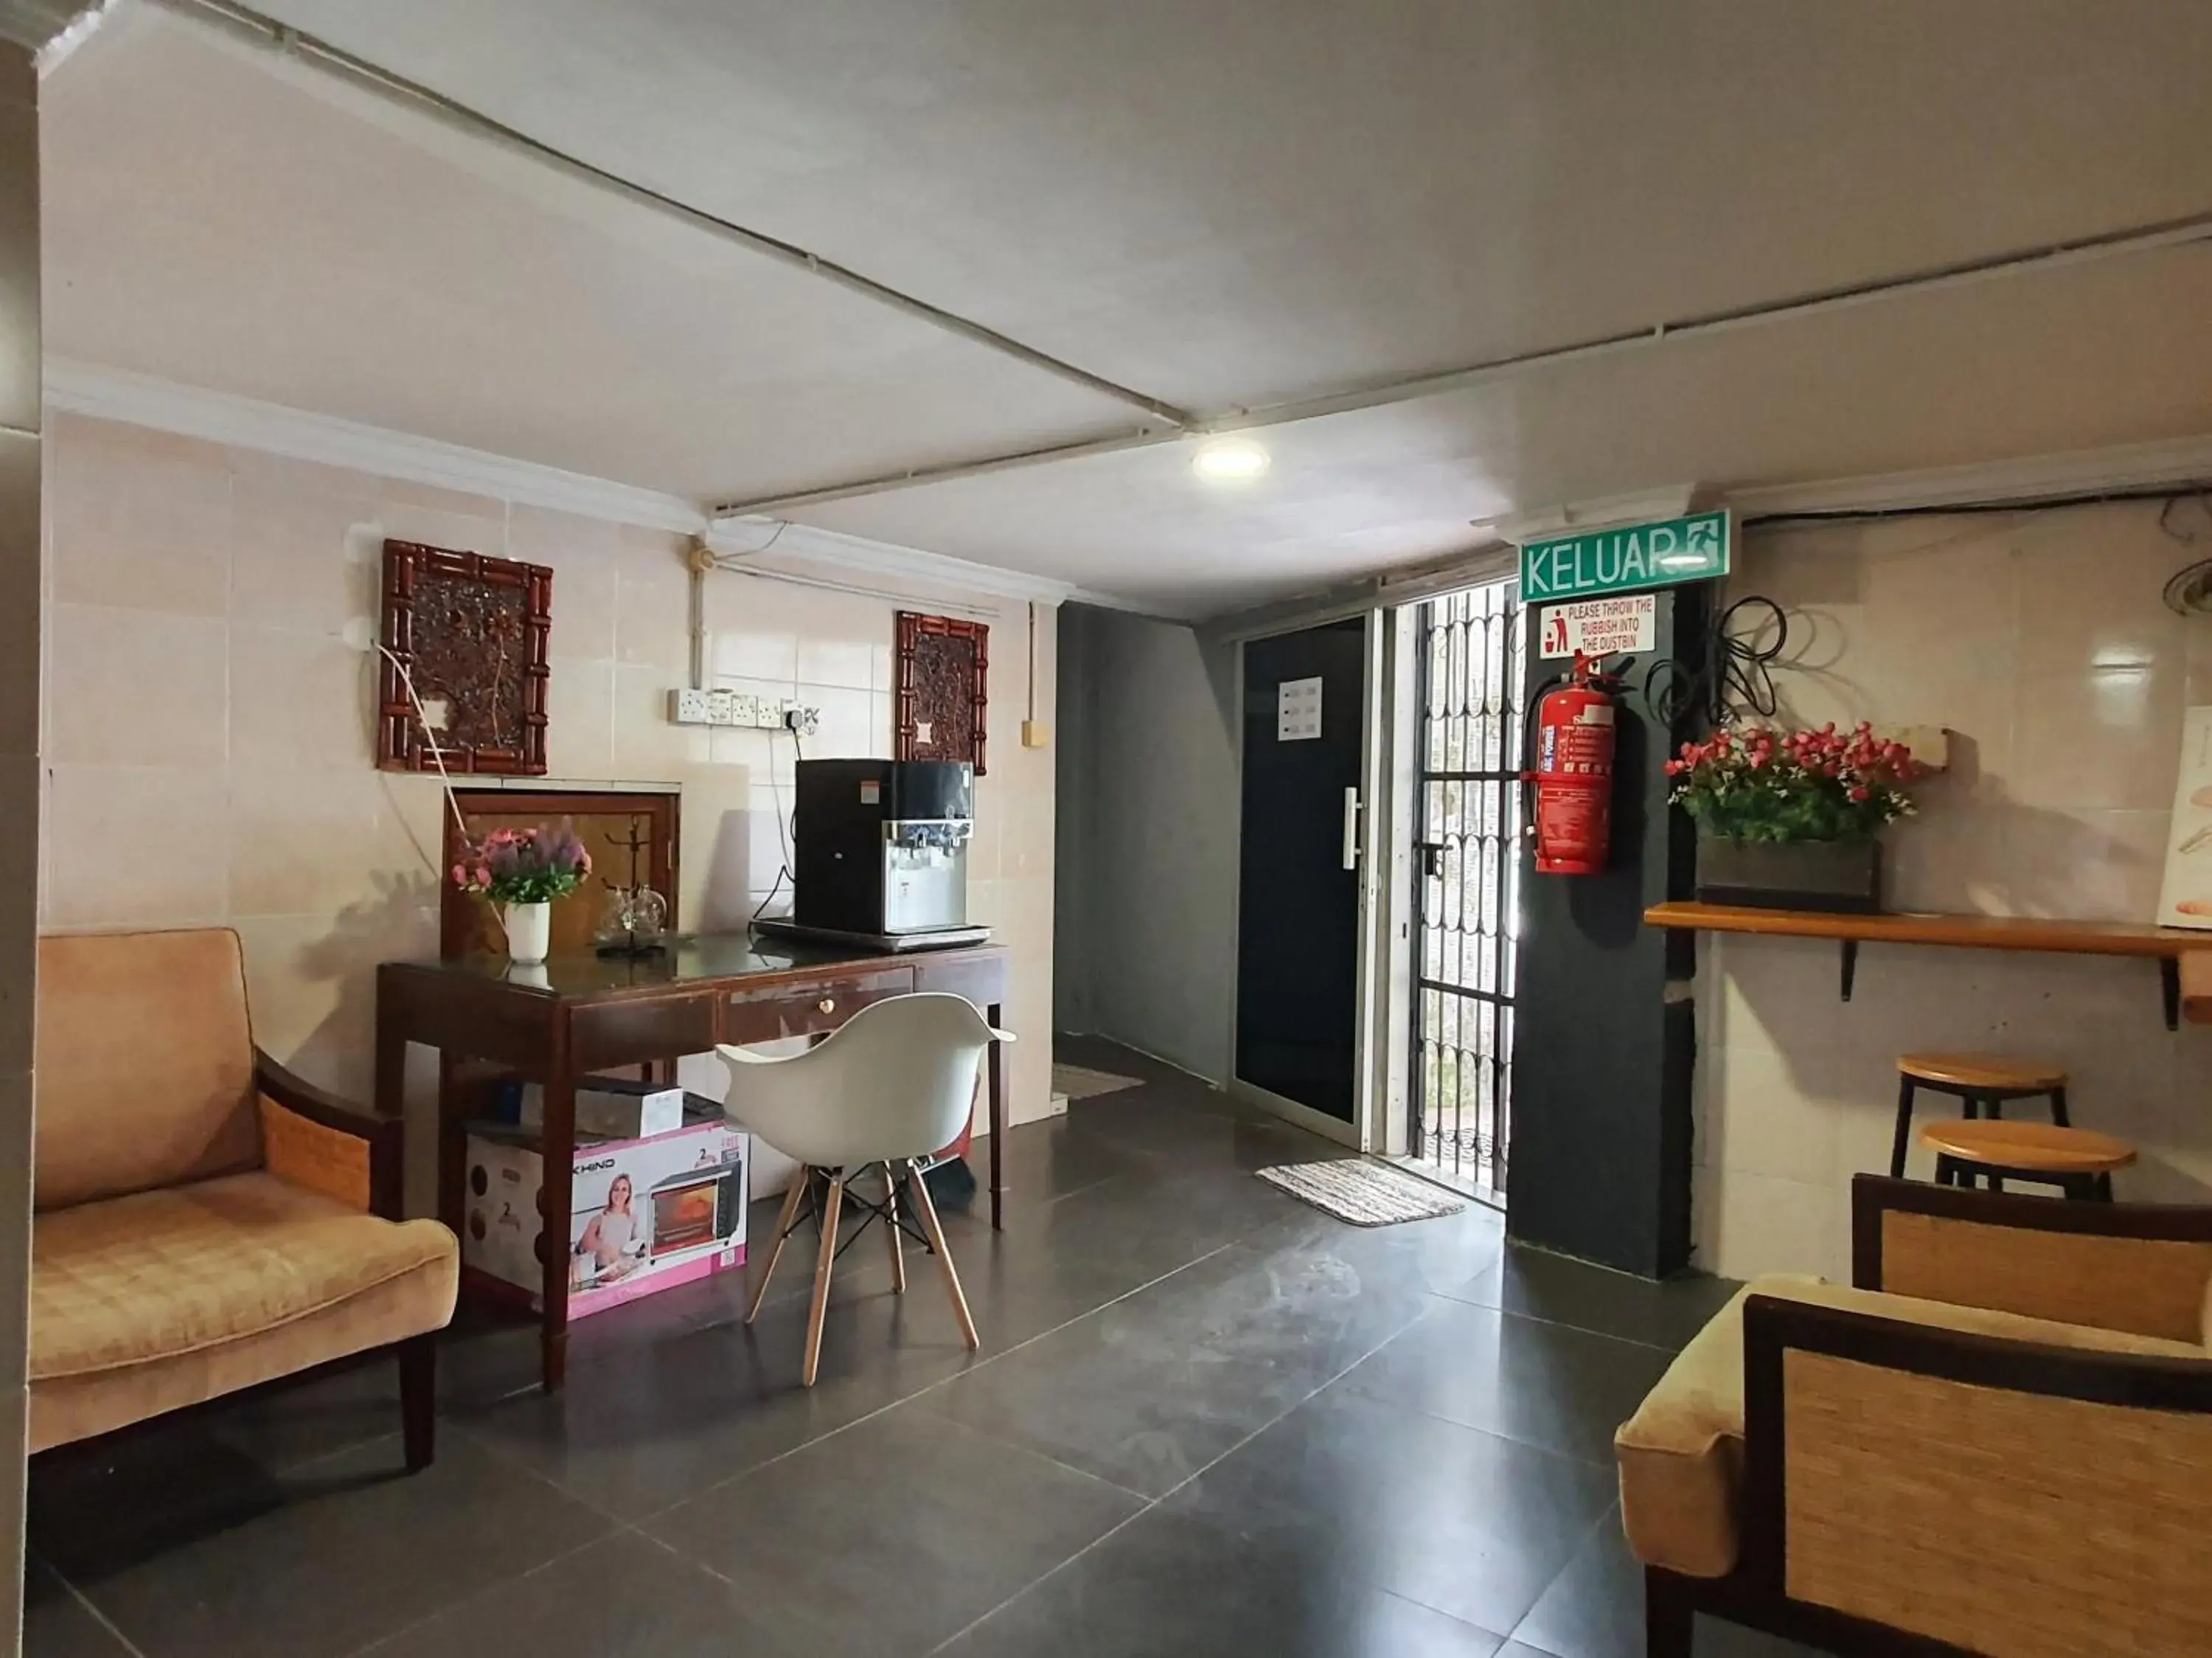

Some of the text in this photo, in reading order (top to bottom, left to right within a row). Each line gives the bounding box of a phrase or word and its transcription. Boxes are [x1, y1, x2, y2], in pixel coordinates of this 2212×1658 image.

[1527, 527, 1678, 594] KELUAR
[1568, 598, 1652, 620] PLEASE THROW THE
[1580, 617, 1639, 635] RUBBISH INTO
[1582, 634, 1637, 651] THE DUSTBIN
[700, 1148, 706, 1160] 2
[503, 1201, 511, 1216] 2
